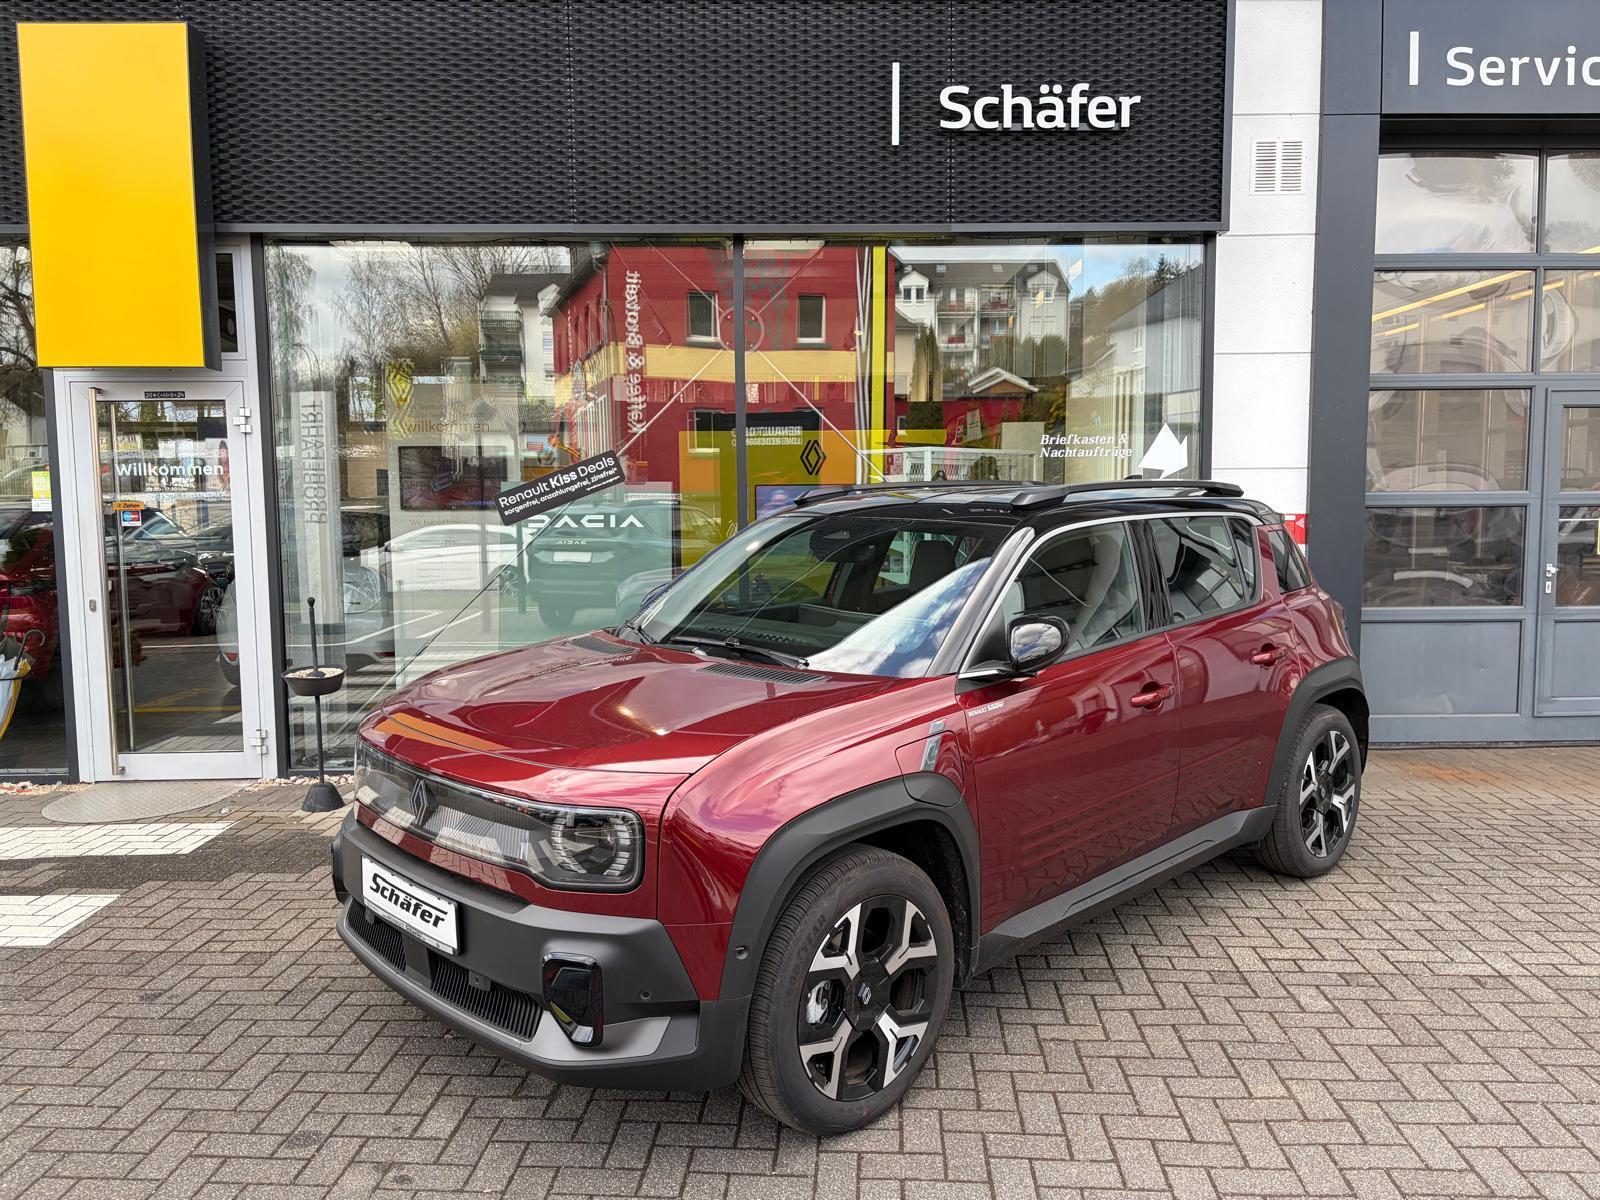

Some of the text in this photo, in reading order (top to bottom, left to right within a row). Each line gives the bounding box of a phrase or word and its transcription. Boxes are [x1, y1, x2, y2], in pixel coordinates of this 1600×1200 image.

[939, 82, 1142, 129] Schäfer
[1040, 433, 1129, 445] Briefkasten &
[1039, 447, 1133, 459] Nachtaufträge
[115, 463, 224, 477] Willkommen
[498, 481, 550, 508] Renault
[549, 471, 578, 489] Kiss
[577, 457, 615, 477] Deals
[527, 514, 644, 528] DACIA
[369, 872, 448, 928] Schäfer
